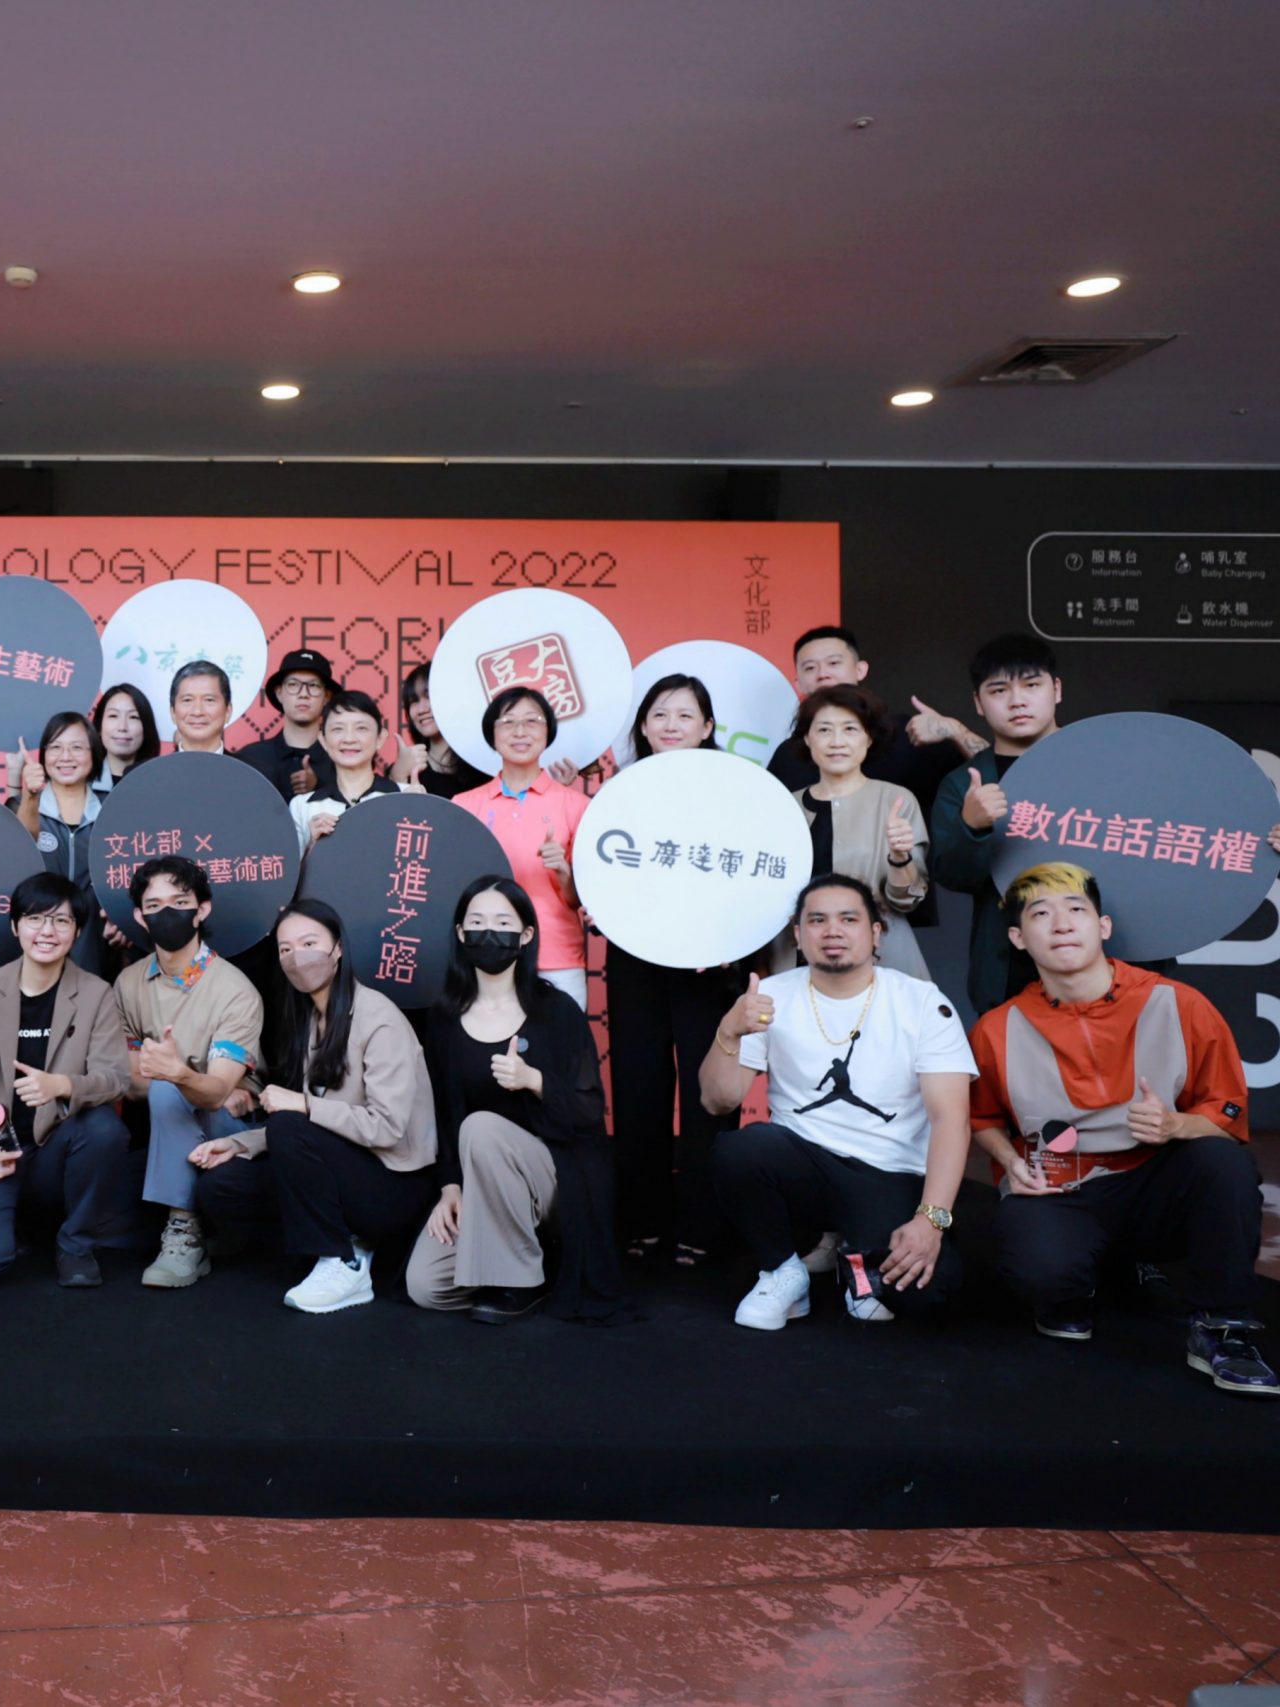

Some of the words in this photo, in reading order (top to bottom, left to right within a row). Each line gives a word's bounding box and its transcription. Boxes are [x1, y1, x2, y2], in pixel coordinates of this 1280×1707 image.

[214, 548, 475, 587] FESTIVAL
[490, 550, 618, 589] 2022
[1091, 567, 1143, 577] Information
[743, 553, 771, 636] 文化部
[1093, 616, 1135, 626] Restroom
[1202, 617, 1228, 627] Water
[1230, 617, 1274, 629] Dispenser
[104, 828, 183, 859] 文化部
[1004, 799, 1262, 874] 數位話語權
[105, 855, 286, 890] 桃藝術節
[649, 838, 788, 880] 廣達電腦
[374, 816, 434, 984] 前進之路
